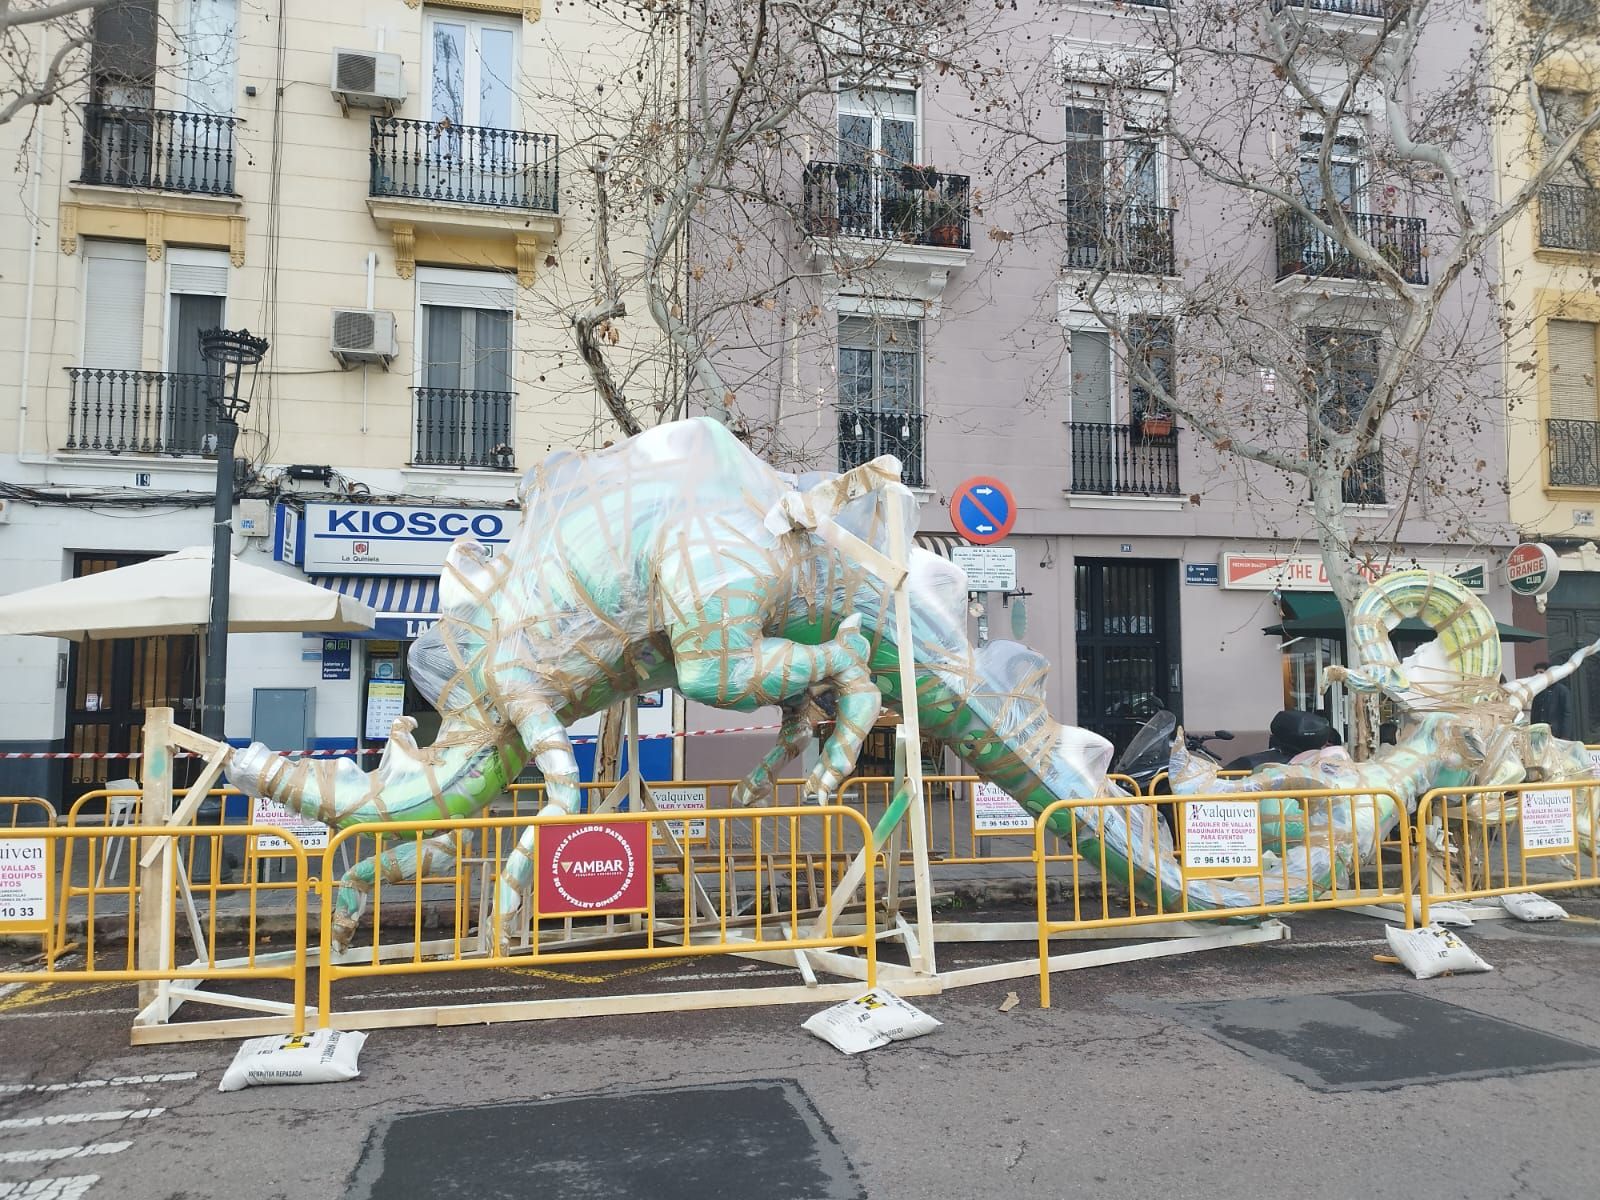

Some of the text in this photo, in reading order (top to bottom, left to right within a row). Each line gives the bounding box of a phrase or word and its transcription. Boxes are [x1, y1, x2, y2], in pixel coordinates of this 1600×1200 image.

[137, 473, 150, 486] 19
[328, 509, 504, 537] KIOSCO
[1513, 554, 1525, 563] THE
[1290, 564, 1313, 579] THE
[1509, 559, 1544, 579] ORANGE
[1526, 575, 1542, 585] CLUB
[656, 791, 704, 804] valquiven
[1202, 804, 1256, 821] valquiven
[567, 825, 603, 841] FALLEROS
[552, 838, 569, 875] ARTISTAS
[605, 827, 634, 878] PATROCINADOR
[1204, 856, 1214, 864] 96
[1216, 856, 1230, 864] 145
[1242, 855, 1252, 863] 33
[572, 859, 624, 873] AMBAR
[2, 907, 34, 916] 10 33
